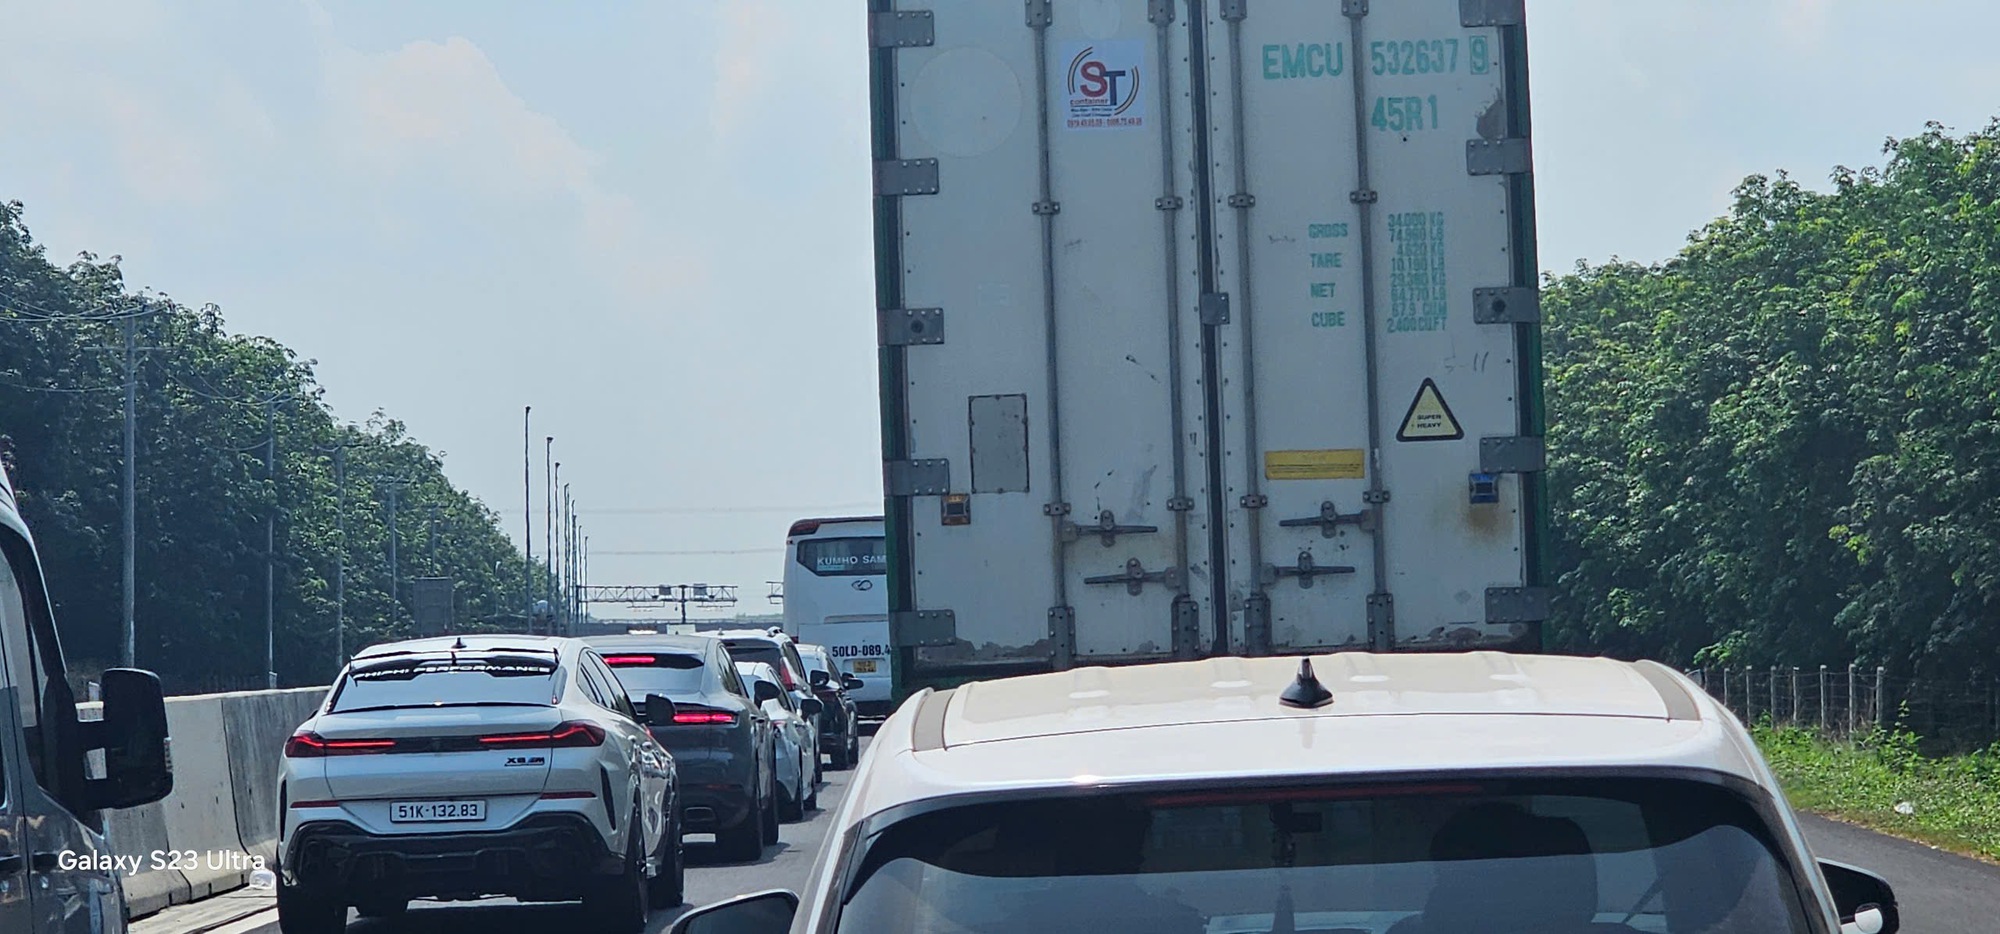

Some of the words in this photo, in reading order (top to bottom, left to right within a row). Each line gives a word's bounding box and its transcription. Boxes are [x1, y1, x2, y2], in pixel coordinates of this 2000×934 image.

[1263, 42, 1343, 80] EMCU
[1370, 38, 1459, 75] 532637
[1471, 37, 1487, 73] 9
[1080, 61, 1126, 106] ST
[1371, 94, 1438, 132] 45R1
[1308, 223, 1348, 238] GROSS
[1310, 253, 1342, 268] TARE
[1310, 282, 1336, 298] NET
[1311, 311, 1345, 327] CUBE
[817, 556, 858, 565] KUMHO
[413, 665, 550, 673] PERFORMANCE
[399, 804, 477, 818] 51K-132.83
